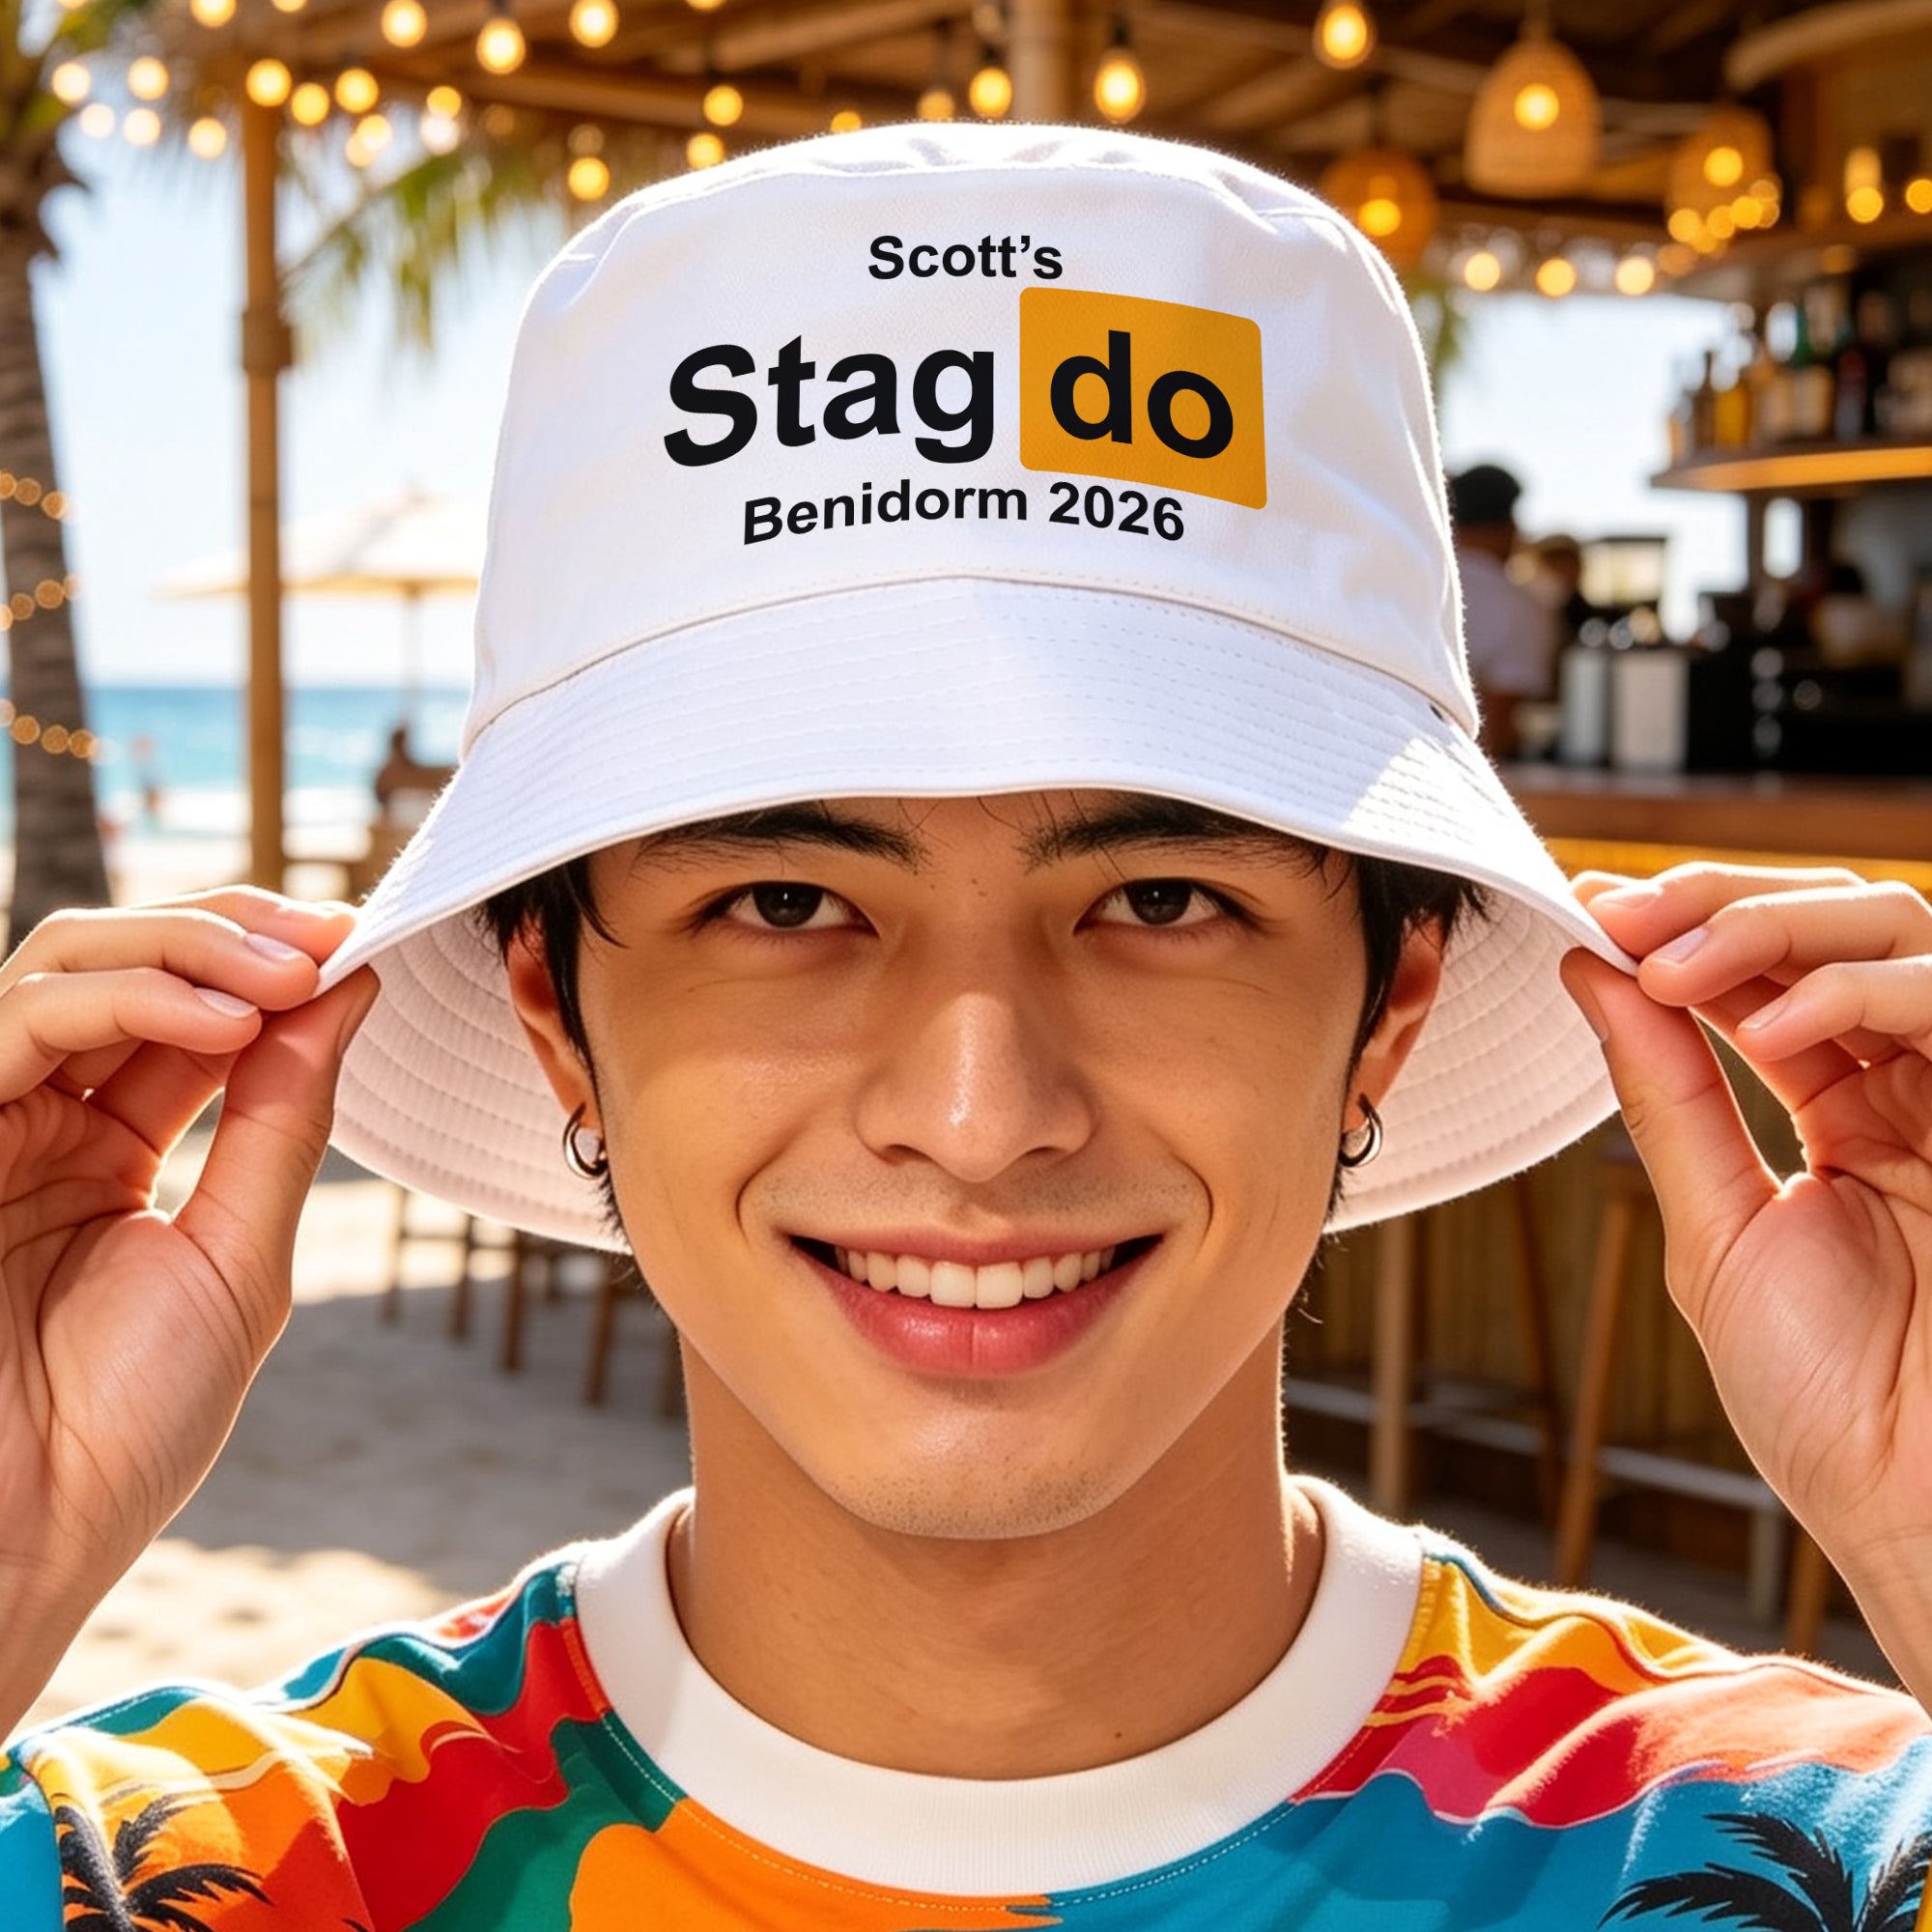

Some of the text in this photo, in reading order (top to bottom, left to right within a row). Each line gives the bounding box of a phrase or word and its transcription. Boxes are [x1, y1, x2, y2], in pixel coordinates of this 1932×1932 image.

[868, 235, 1063, 280] Scott’s
[664, 329, 1234, 468] Stag do
[744, 478, 1184, 545] Benidorm 2026
